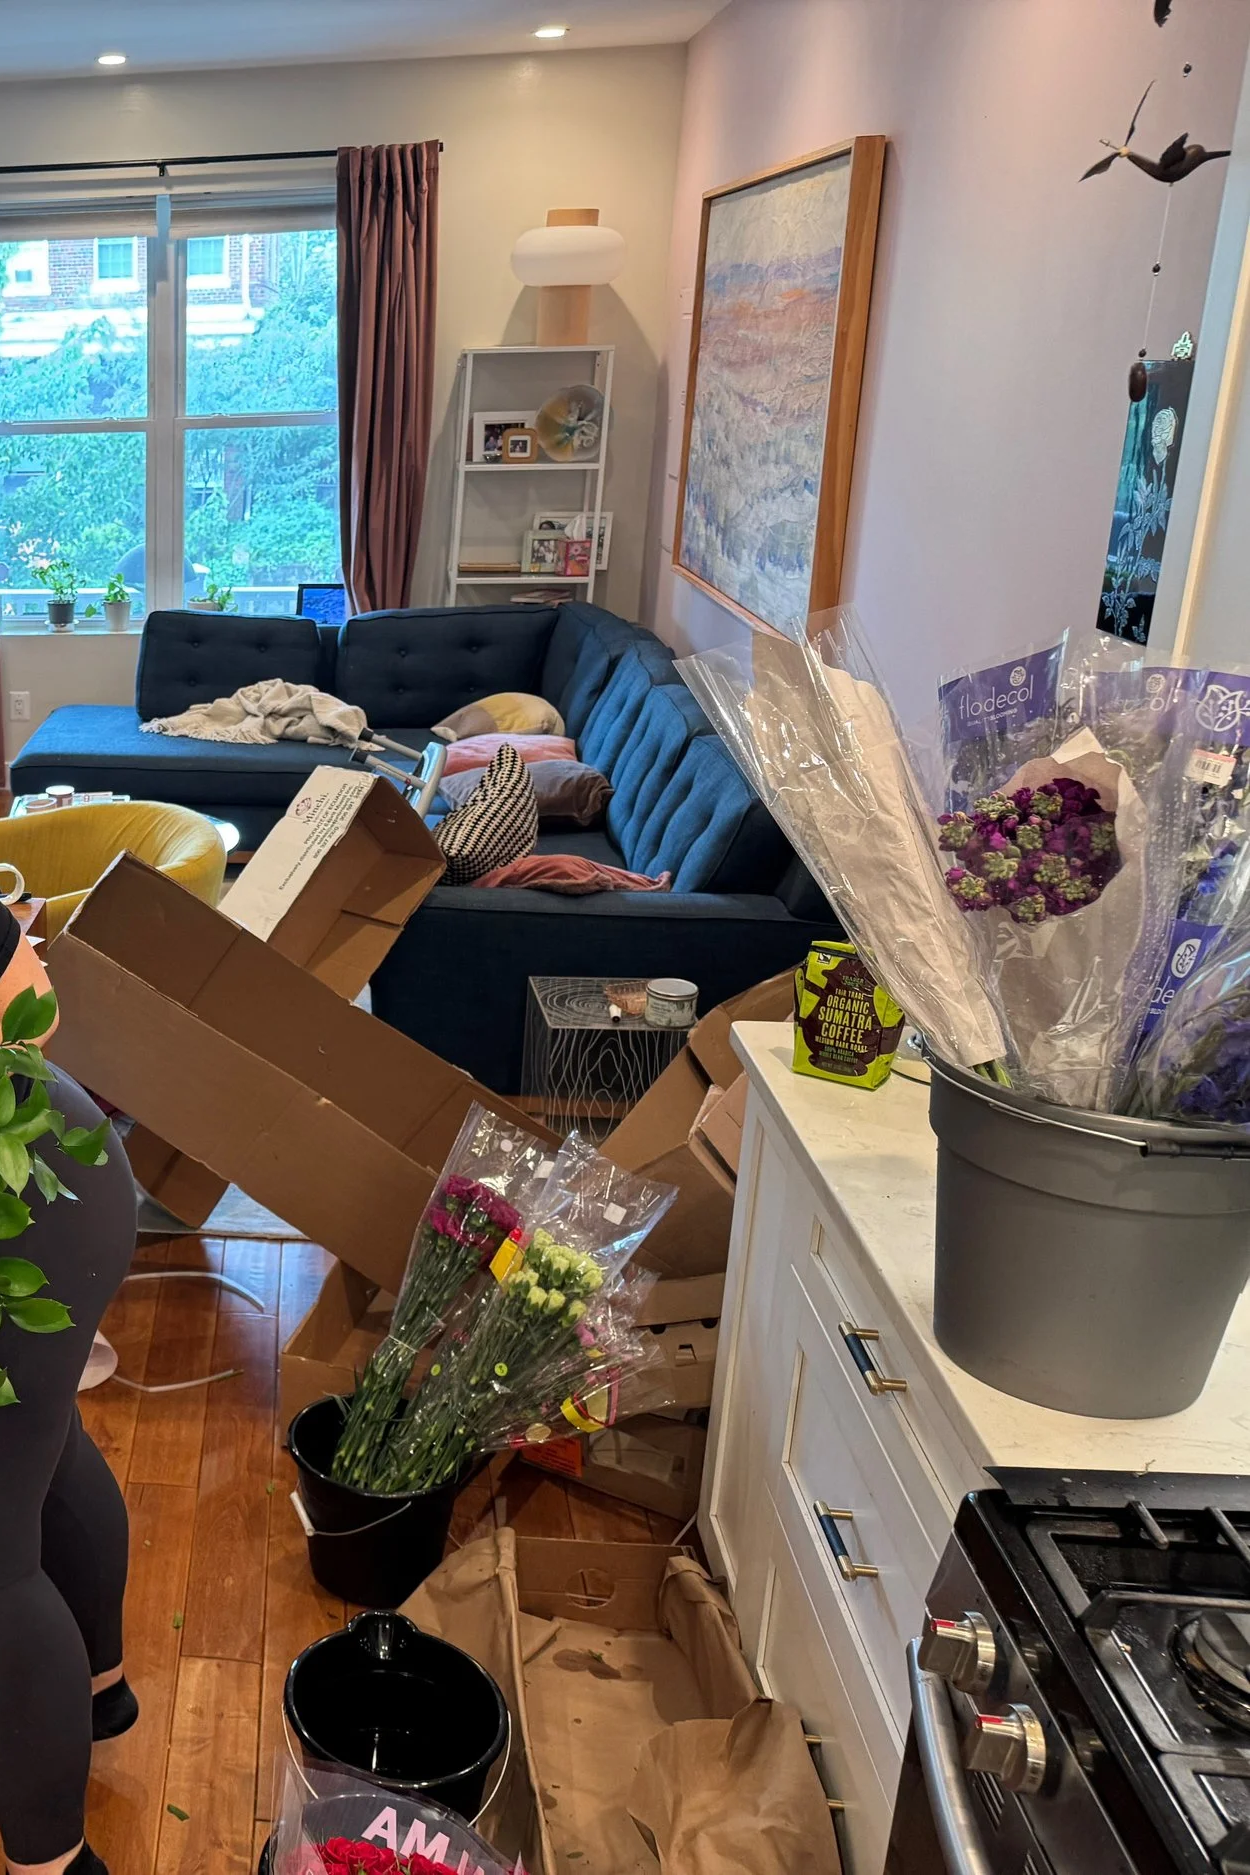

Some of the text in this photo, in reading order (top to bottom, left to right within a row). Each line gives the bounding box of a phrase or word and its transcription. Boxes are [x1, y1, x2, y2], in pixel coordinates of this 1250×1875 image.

[959, 674, 1034, 720] flodecol
[826, 994, 870, 1015] ORGANIC
[835, 988, 865, 1000] FAIR TRADE
[818, 1006, 873, 1031] SUMATRA
[821, 1022, 865, 1045] COFFEE
[835, 1039, 849, 1050] DARK
